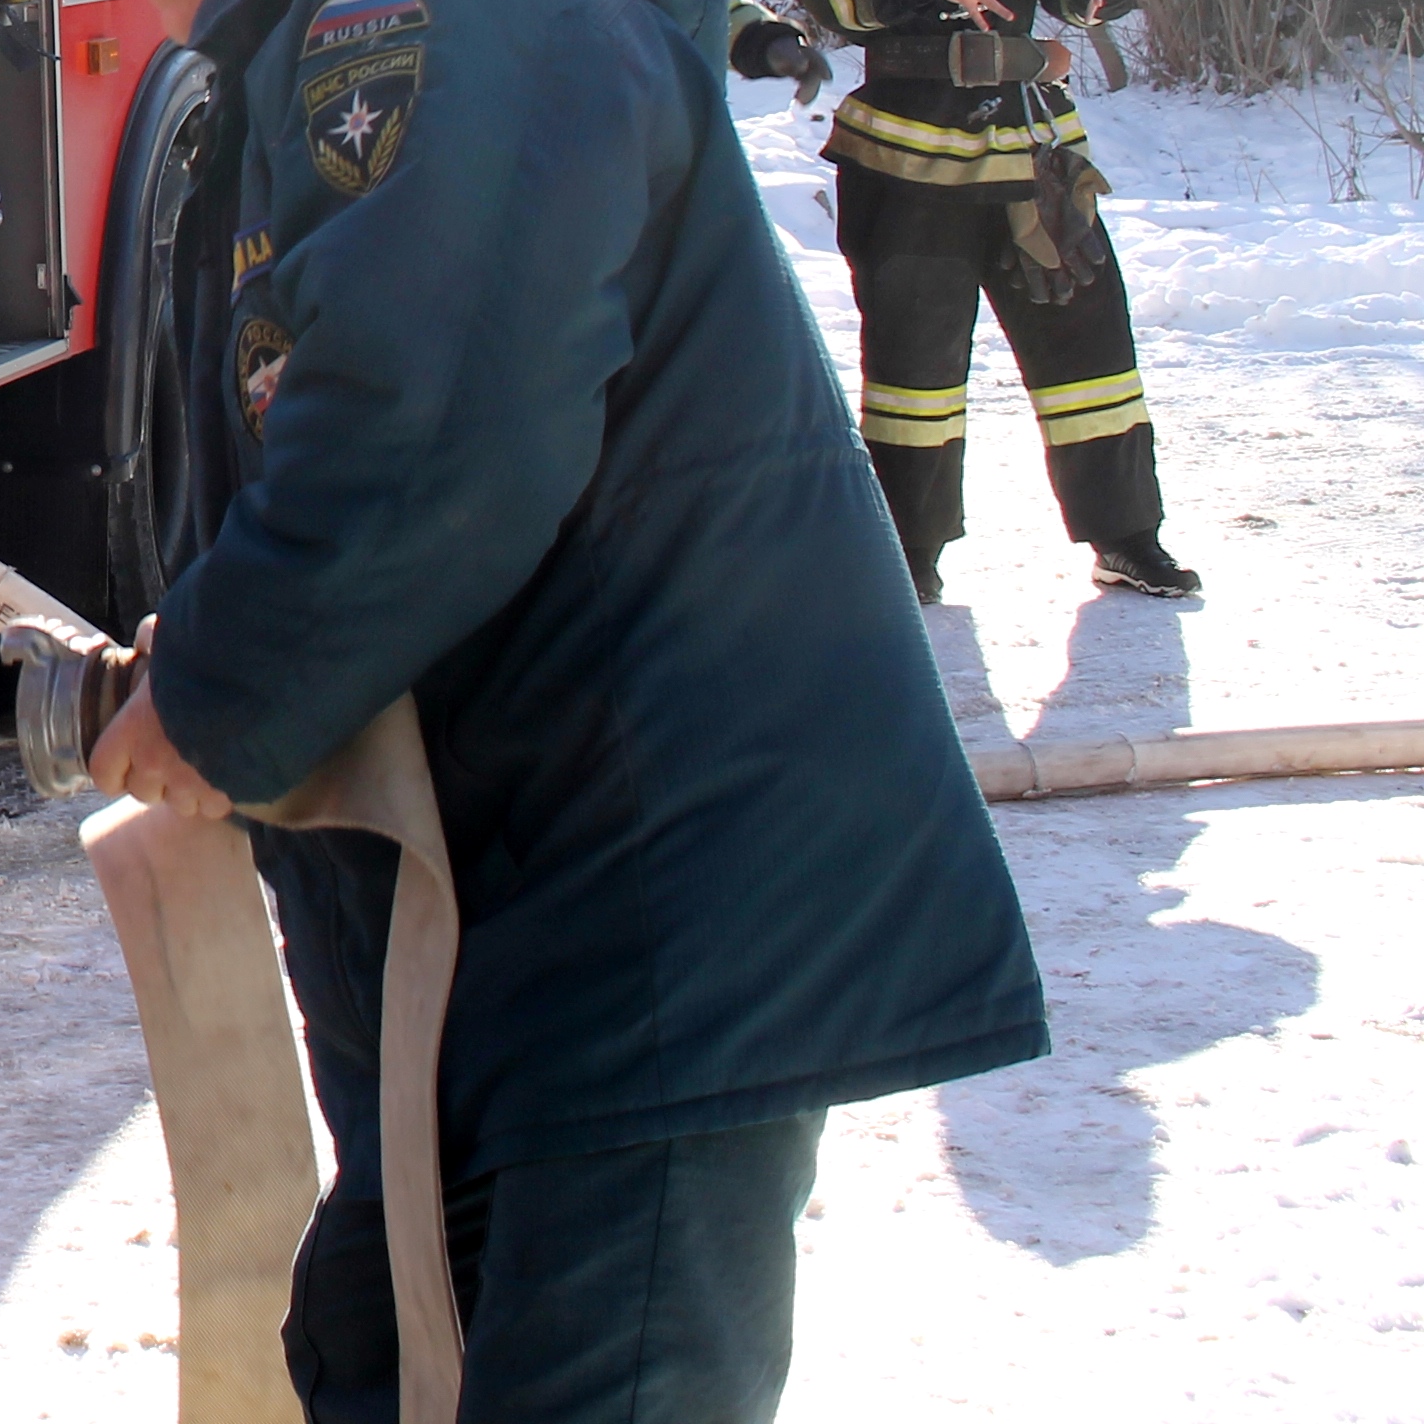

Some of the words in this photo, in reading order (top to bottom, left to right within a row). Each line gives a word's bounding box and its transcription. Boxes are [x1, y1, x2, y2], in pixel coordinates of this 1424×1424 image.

[322, 14, 402, 46] RUSSIA
[310, 73, 346, 105] МЧС
[347, 53, 415, 86] РОССИИ
